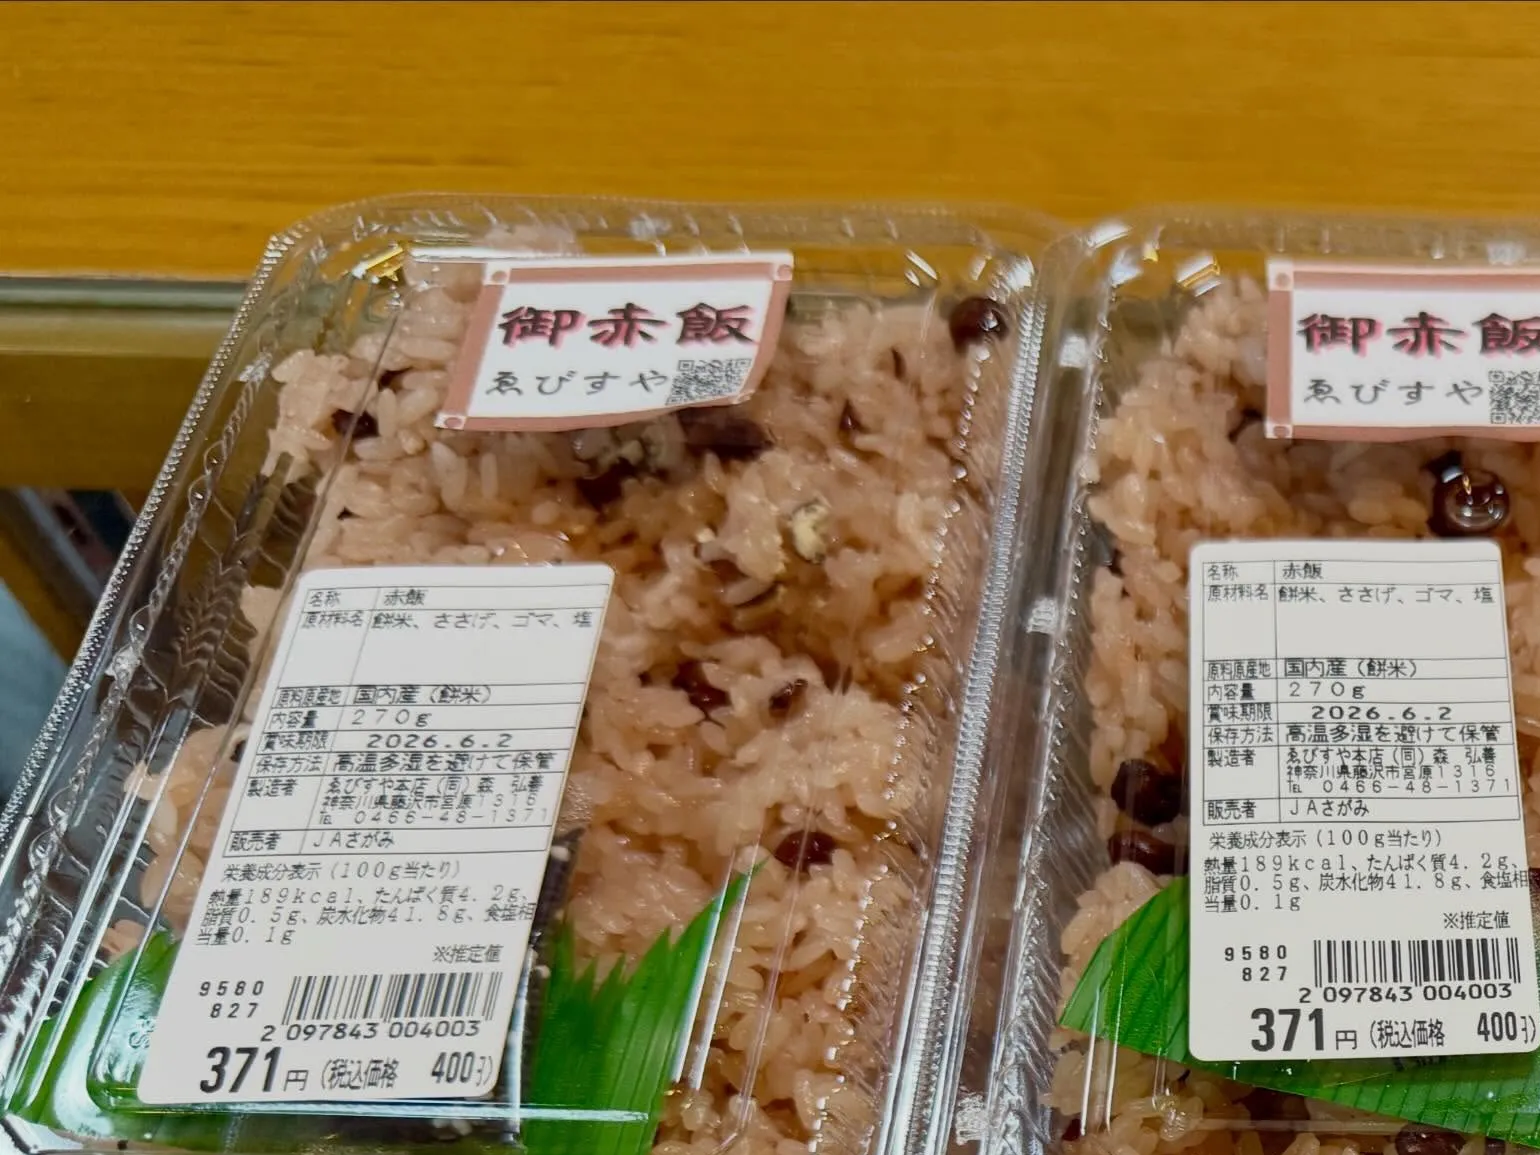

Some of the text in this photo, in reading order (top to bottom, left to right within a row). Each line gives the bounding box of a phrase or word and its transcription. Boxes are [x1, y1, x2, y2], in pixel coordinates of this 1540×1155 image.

[498, 302, 757, 348] 御赤飯
[485, 370, 669, 395] ゑびすや
[1303, 379, 1484, 405] ゑびすや
[1207, 563, 1323, 581] 名称 赤飯
[1207, 585, 1269, 602] 原材料名
[1207, 660, 1272, 680] 原料原産地
[1207, 681, 1367, 701] 内容量 270g
[1207, 703, 1453, 723] 賞味期限 2026.6.2
[1207, 725, 1500, 744] 保存方法 高温多湿を避けて保管
[1207, 748, 1256, 768] 製造者
[1207, 799, 1370, 820] 販売者 JAさがみ
[1224, 945, 1287, 961] 9580
[1242, 966, 1287, 982] 827
[198, 980, 265, 997] 9580
[209, 1002, 260, 1019] 827
